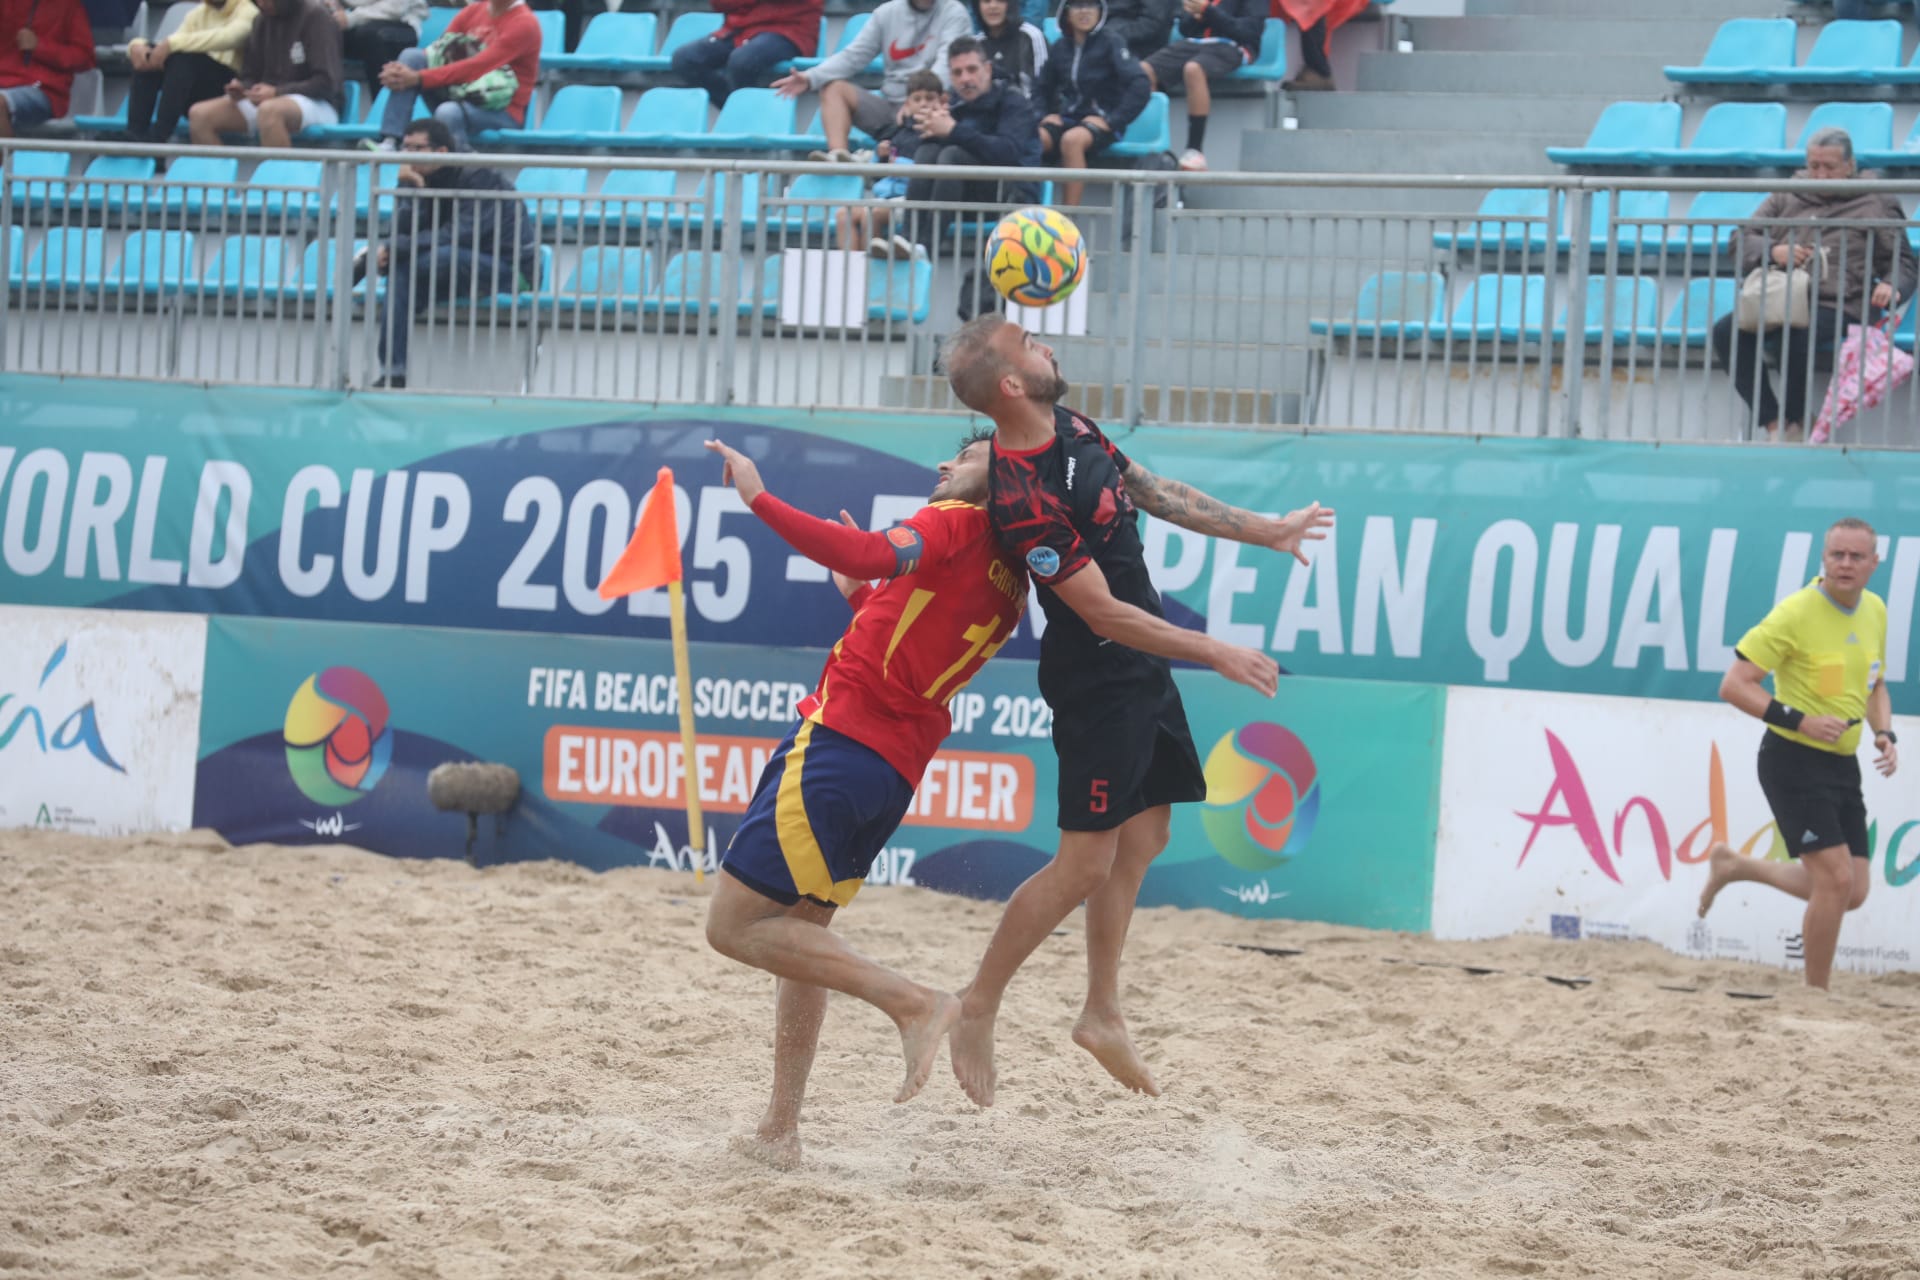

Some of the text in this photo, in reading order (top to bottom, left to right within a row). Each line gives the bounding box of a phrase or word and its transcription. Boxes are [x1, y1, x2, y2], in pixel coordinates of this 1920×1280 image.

[278, 464, 472, 603] CUP
[527, 667, 588, 710] FIFA
[694, 676, 808, 723] SOCCER
[948, 692, 986, 734] UP
[990, 695, 1055, 739] 202
[1089, 779, 1109, 814] 5
[864, 847, 916, 887] DIZ
